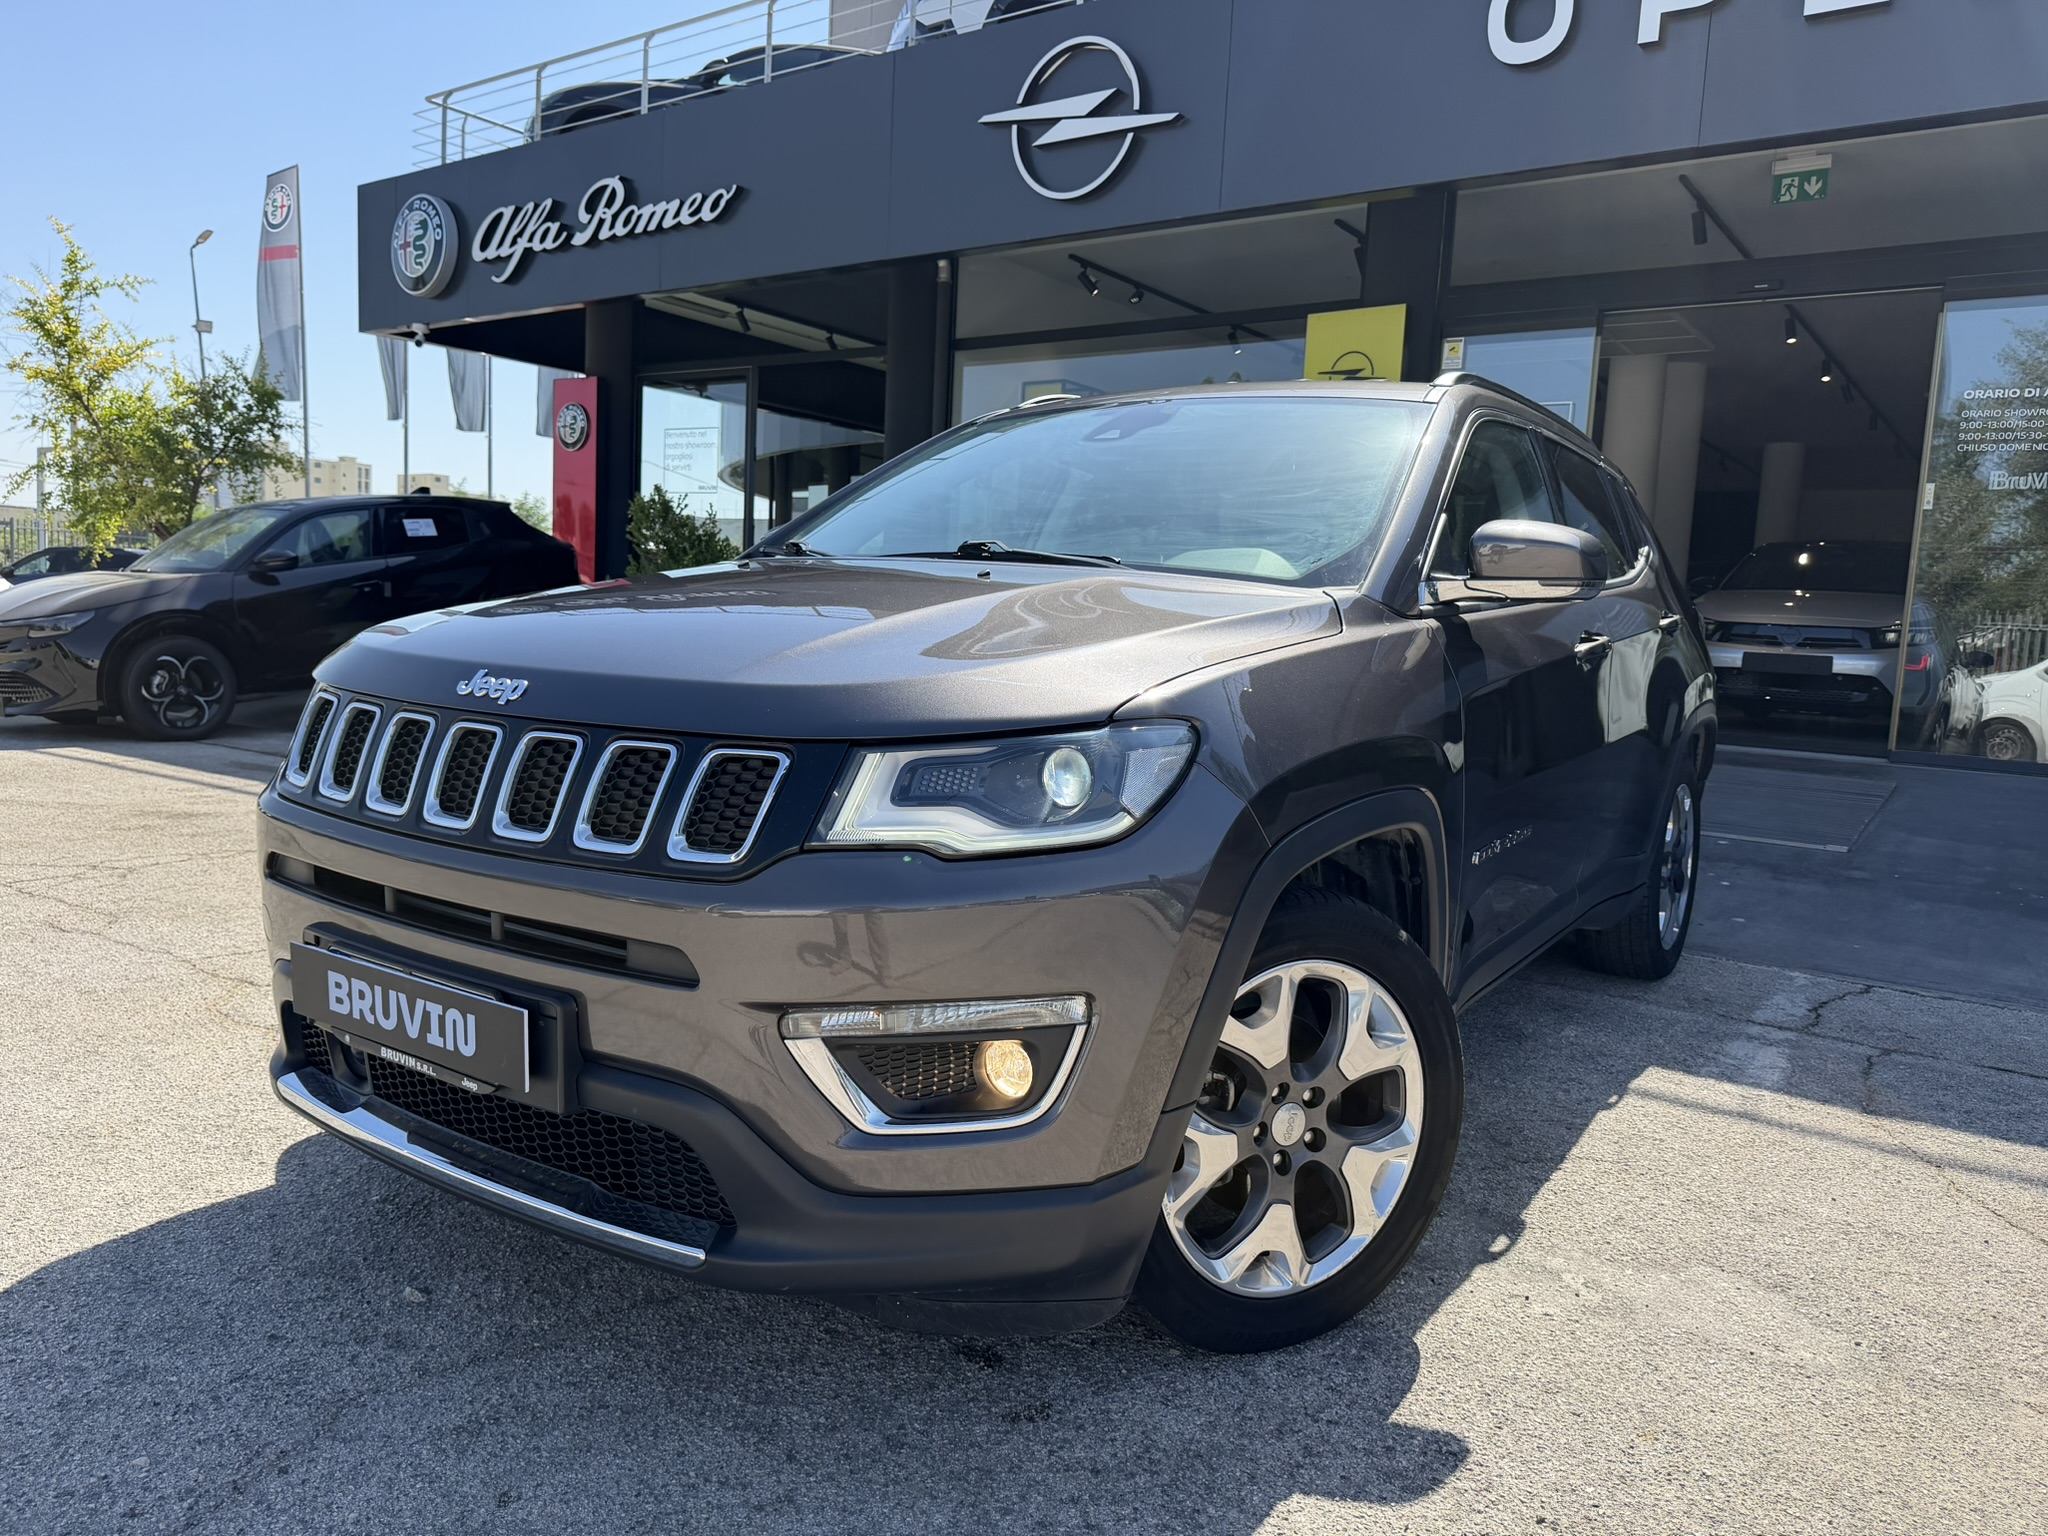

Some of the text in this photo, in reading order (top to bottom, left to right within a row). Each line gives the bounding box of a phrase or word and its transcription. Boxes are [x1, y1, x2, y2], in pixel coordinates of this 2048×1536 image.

[413, 200, 443, 241] ROMEO
[472, 175, 737, 283] Alfa Romeo
[1964, 389, 2021, 400] ORARIO
[2024, 388, 2041, 398] DI
[1961, 409, 2002, 418] ORARIO
[1957, 443, 1997, 452] CHIUSO
[457, 669, 528, 704] Jeep
[327, 970, 476, 1057] BRUVIN
[380, 1046, 416, 1069] BRUVIN
[461, 1077, 478, 1092] Jeep
